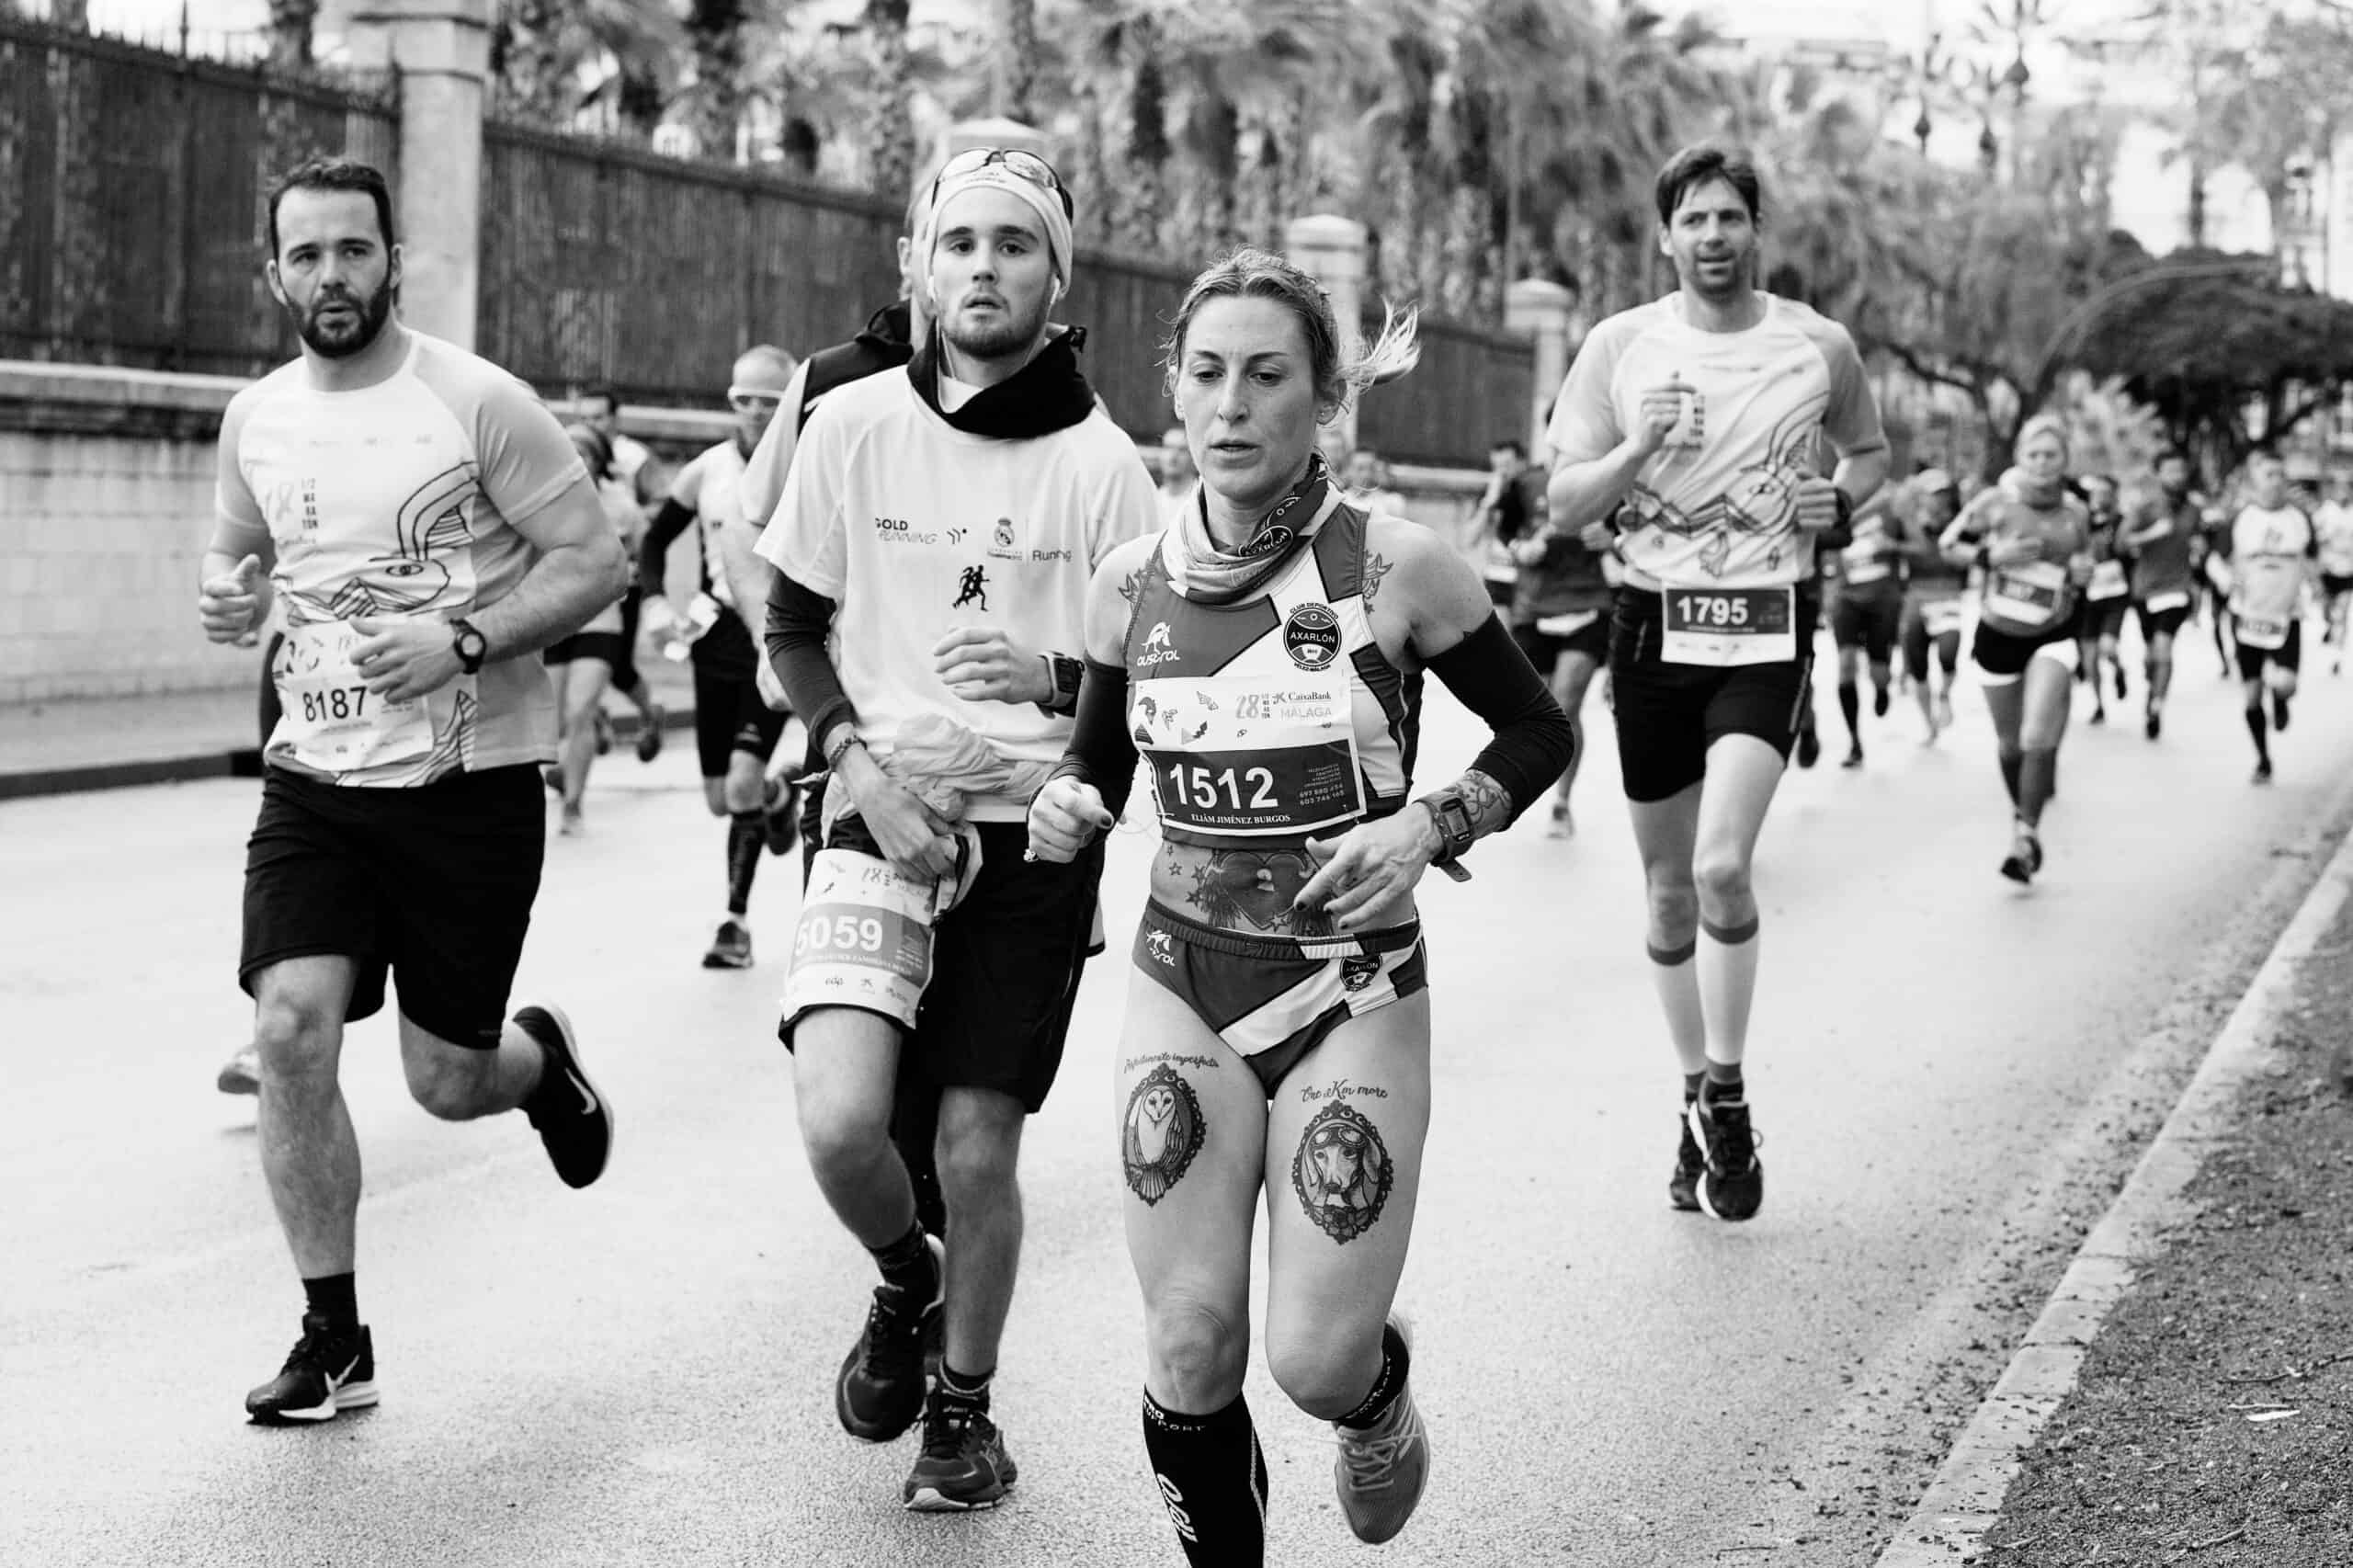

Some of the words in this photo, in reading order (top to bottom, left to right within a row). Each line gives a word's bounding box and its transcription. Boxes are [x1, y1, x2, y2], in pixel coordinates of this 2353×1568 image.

[1677, 595, 1749, 626] 1795
[1290, 631, 1336, 643] AXARLÓN
[301, 686, 369, 722] 8187
[1288, 690, 1332, 700] CaixaBank
[1235, 693, 1259, 719] 28
[1170, 763, 1279, 809] 1512
[1254, 814, 1291, 824] BURGOS
[1357, 1085, 1389, 1099] more
